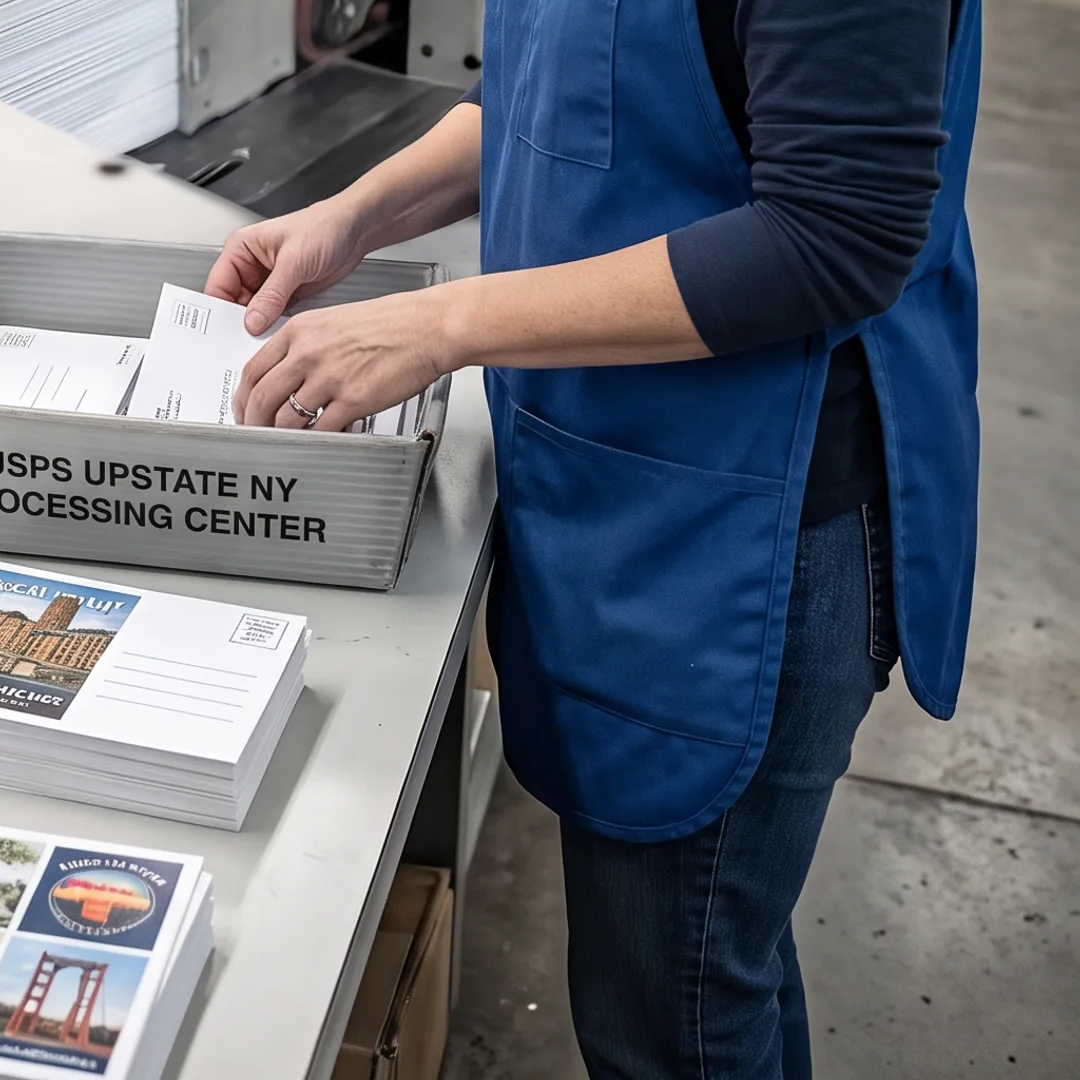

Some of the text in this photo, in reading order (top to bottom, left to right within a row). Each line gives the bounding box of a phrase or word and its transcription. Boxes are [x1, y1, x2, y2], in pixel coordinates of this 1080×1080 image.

[84, 460, 238, 498] UPSTATE
[251, 475, 298, 502] NY
[185, 507, 326, 543] CENTER
